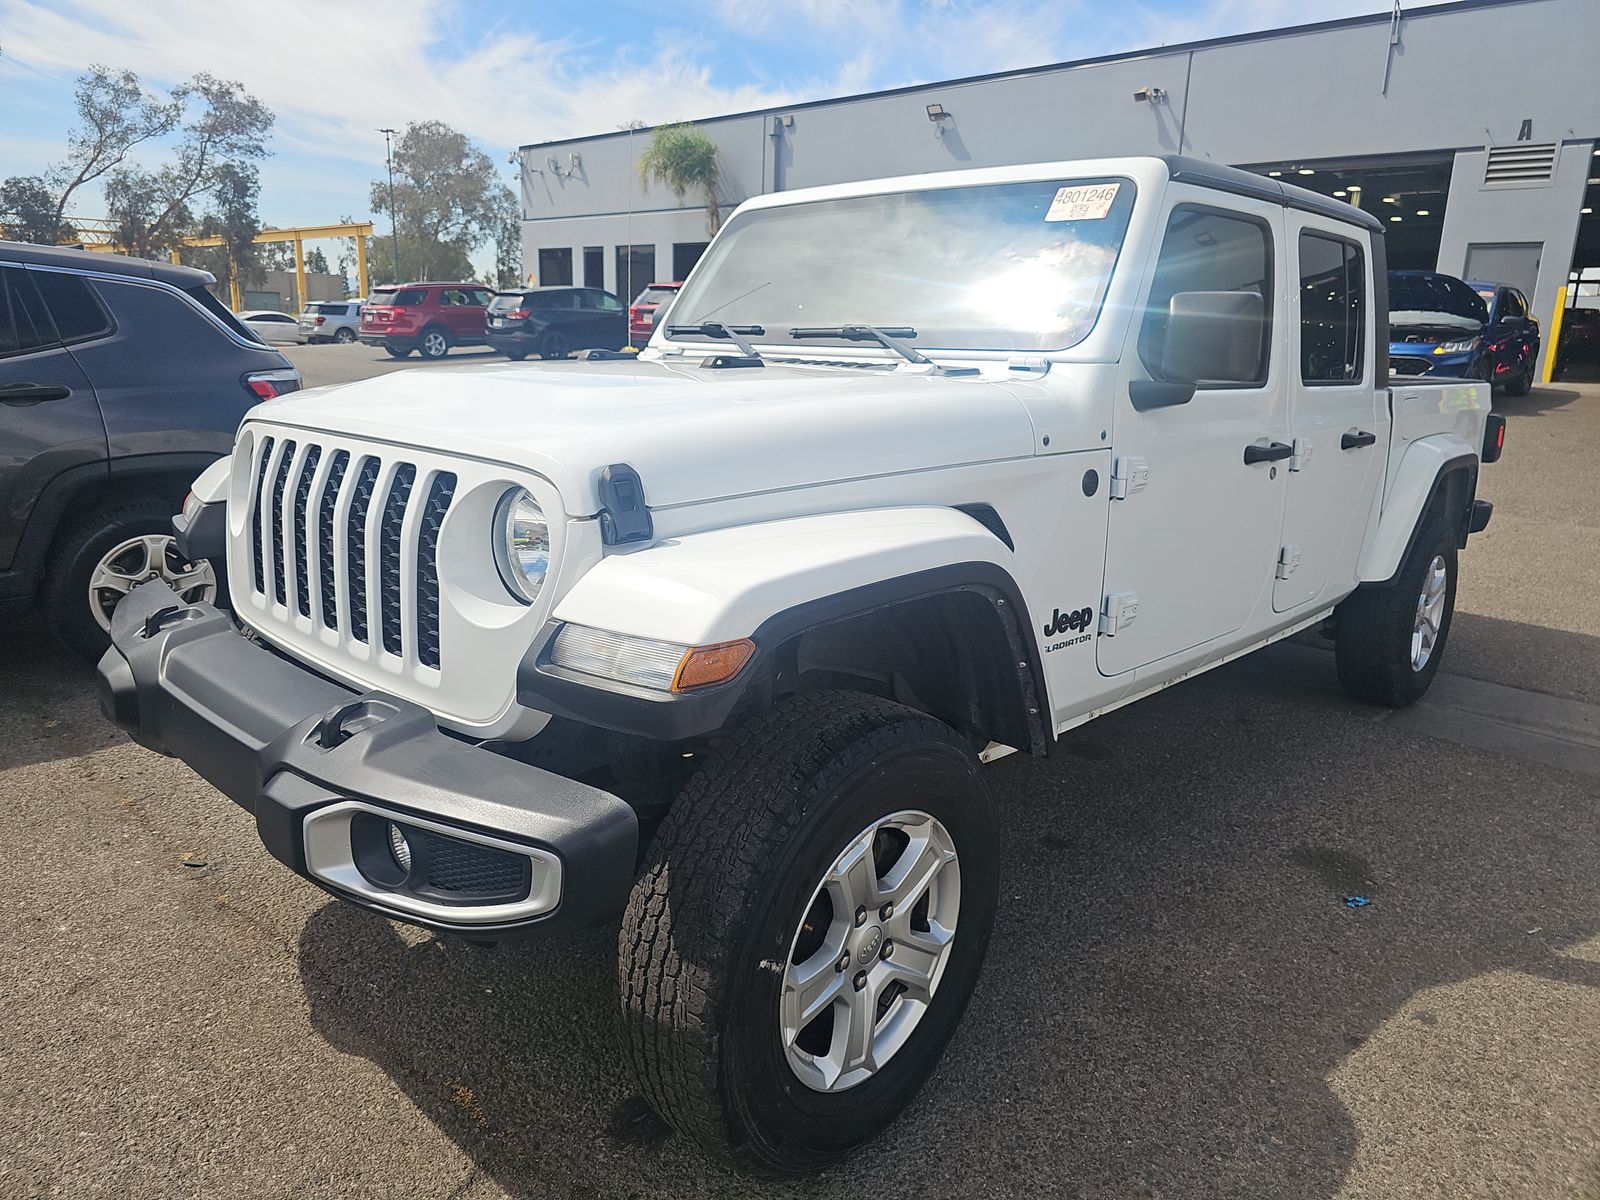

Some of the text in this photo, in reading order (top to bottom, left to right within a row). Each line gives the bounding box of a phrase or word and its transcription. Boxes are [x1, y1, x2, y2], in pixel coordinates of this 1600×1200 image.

[1517, 118, 1533, 141] A
[1055, 187, 1116, 205] 4801246
[1044, 606, 1093, 637] Jeep
